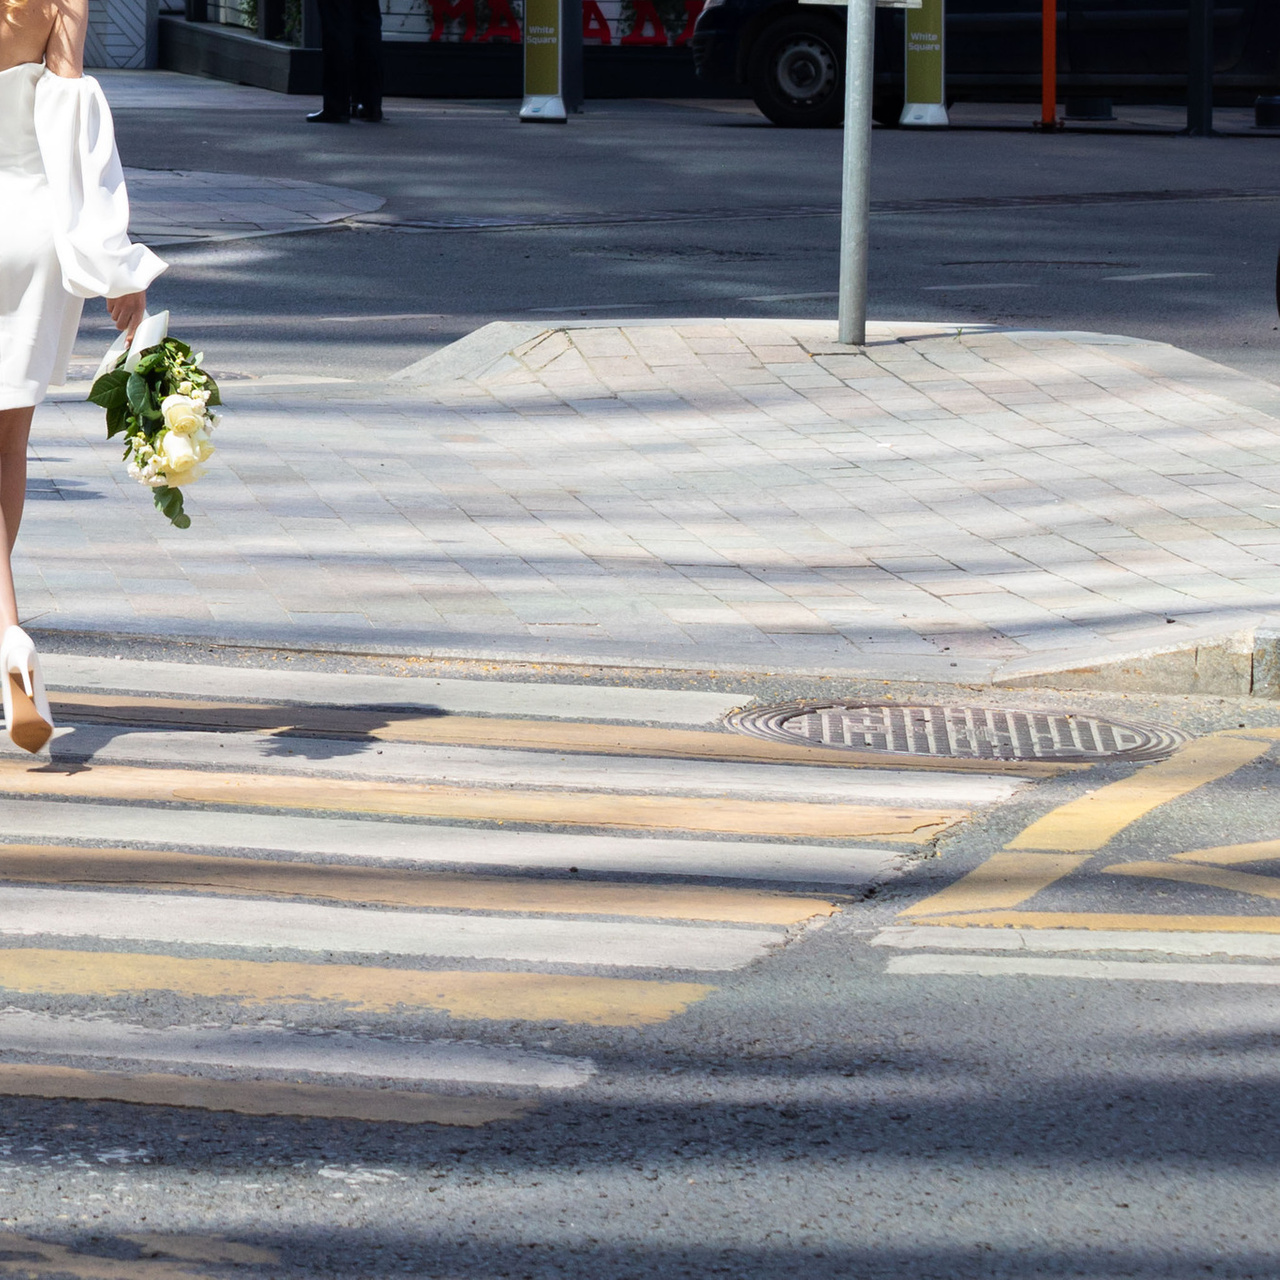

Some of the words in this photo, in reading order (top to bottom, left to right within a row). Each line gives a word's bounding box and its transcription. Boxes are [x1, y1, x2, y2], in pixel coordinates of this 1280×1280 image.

[529, 26, 555, 34] White
[526, 36, 557, 44] Square
[911, 32, 938, 41] White
[908, 42, 940, 51] Square
